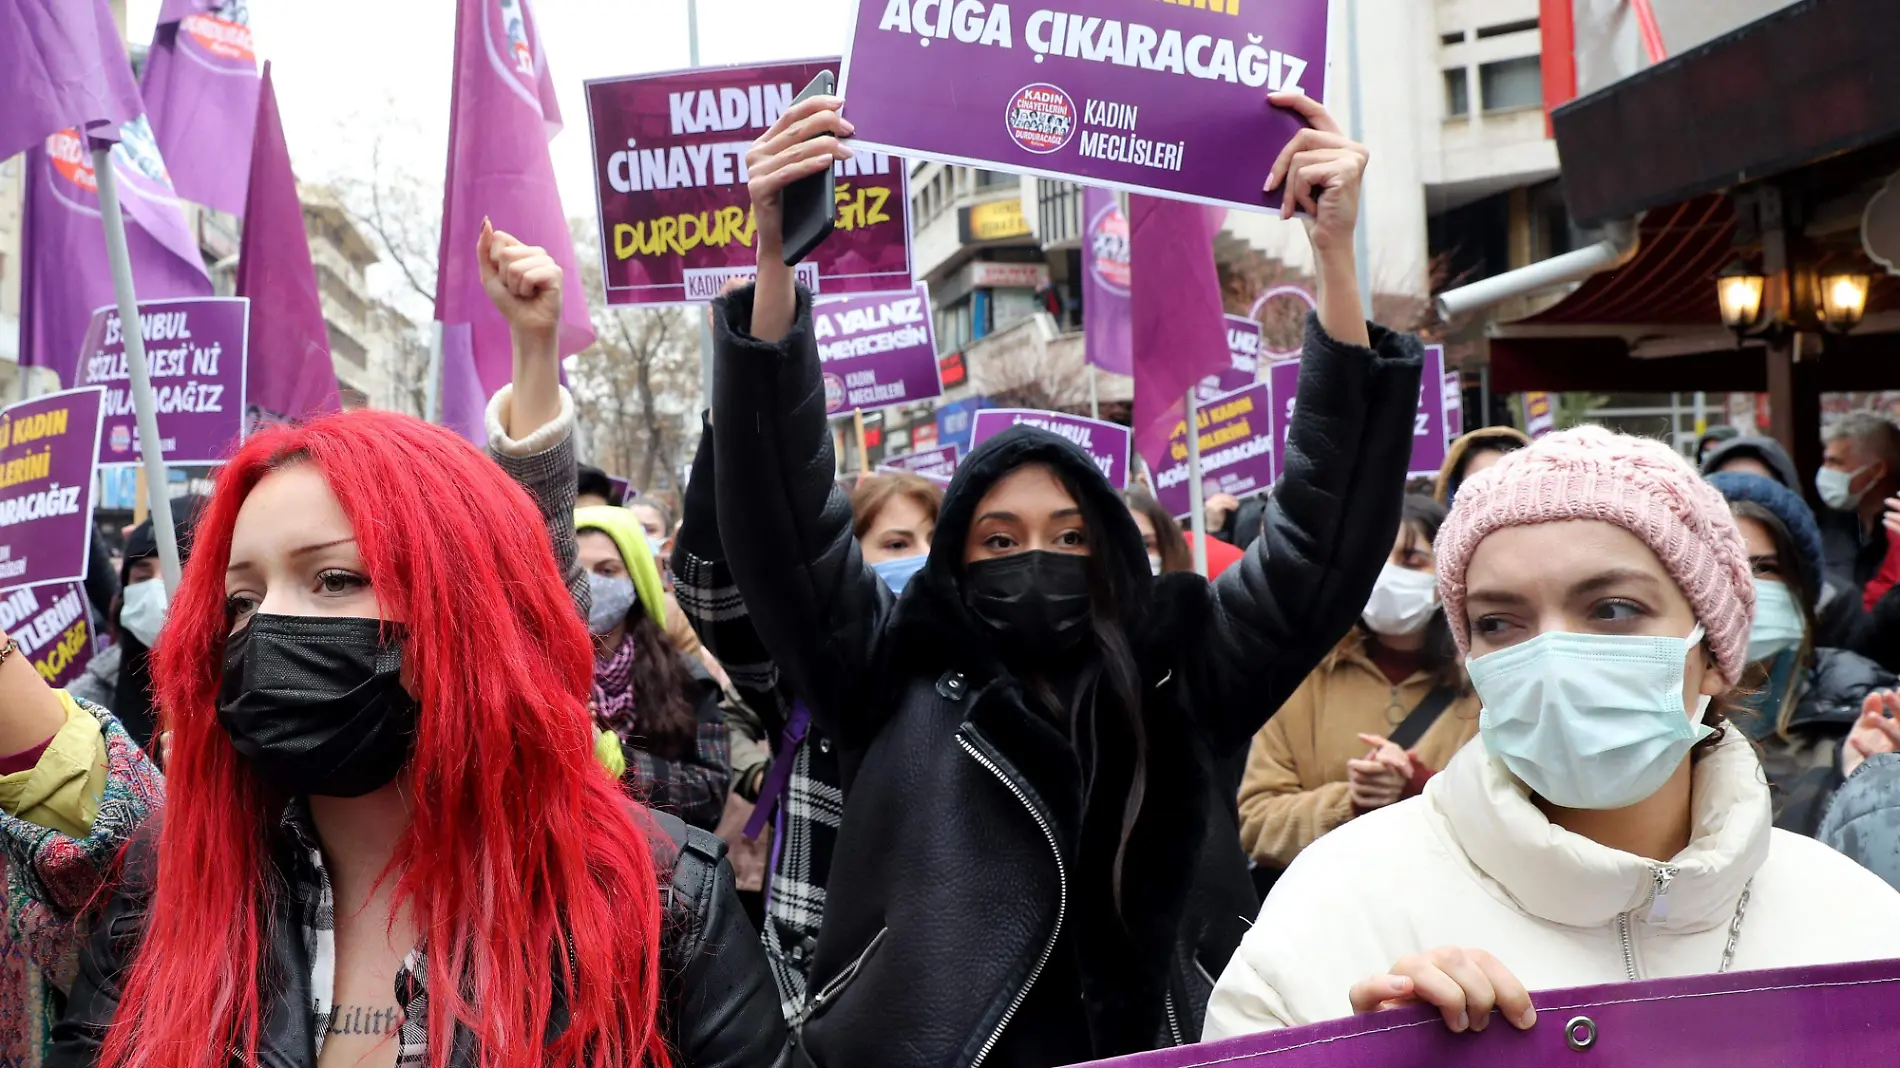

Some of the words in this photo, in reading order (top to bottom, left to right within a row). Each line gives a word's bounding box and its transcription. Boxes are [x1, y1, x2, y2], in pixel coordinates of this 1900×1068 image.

[879, 0, 1012, 48] AÇIGA
[1025, 10, 1308, 95] ÇIKARACAĞIZ
[668, 83, 793, 136] KADIN
[1023, 89, 1063, 105] KADIN
[1084, 99, 1138, 131] KADIN
[607, 138, 890, 194] CİNAYETN
[1079, 131, 1185, 171] MECLİSLERİ
[613, 183, 891, 261] DURDURĞIZ
[104, 312, 192, 346] İSNBUL
[834, 297, 924, 335] YALNIZ
[86, 341, 222, 383] SÖZLEESİ'Nİ
[12, 408, 68, 445] KADIN
